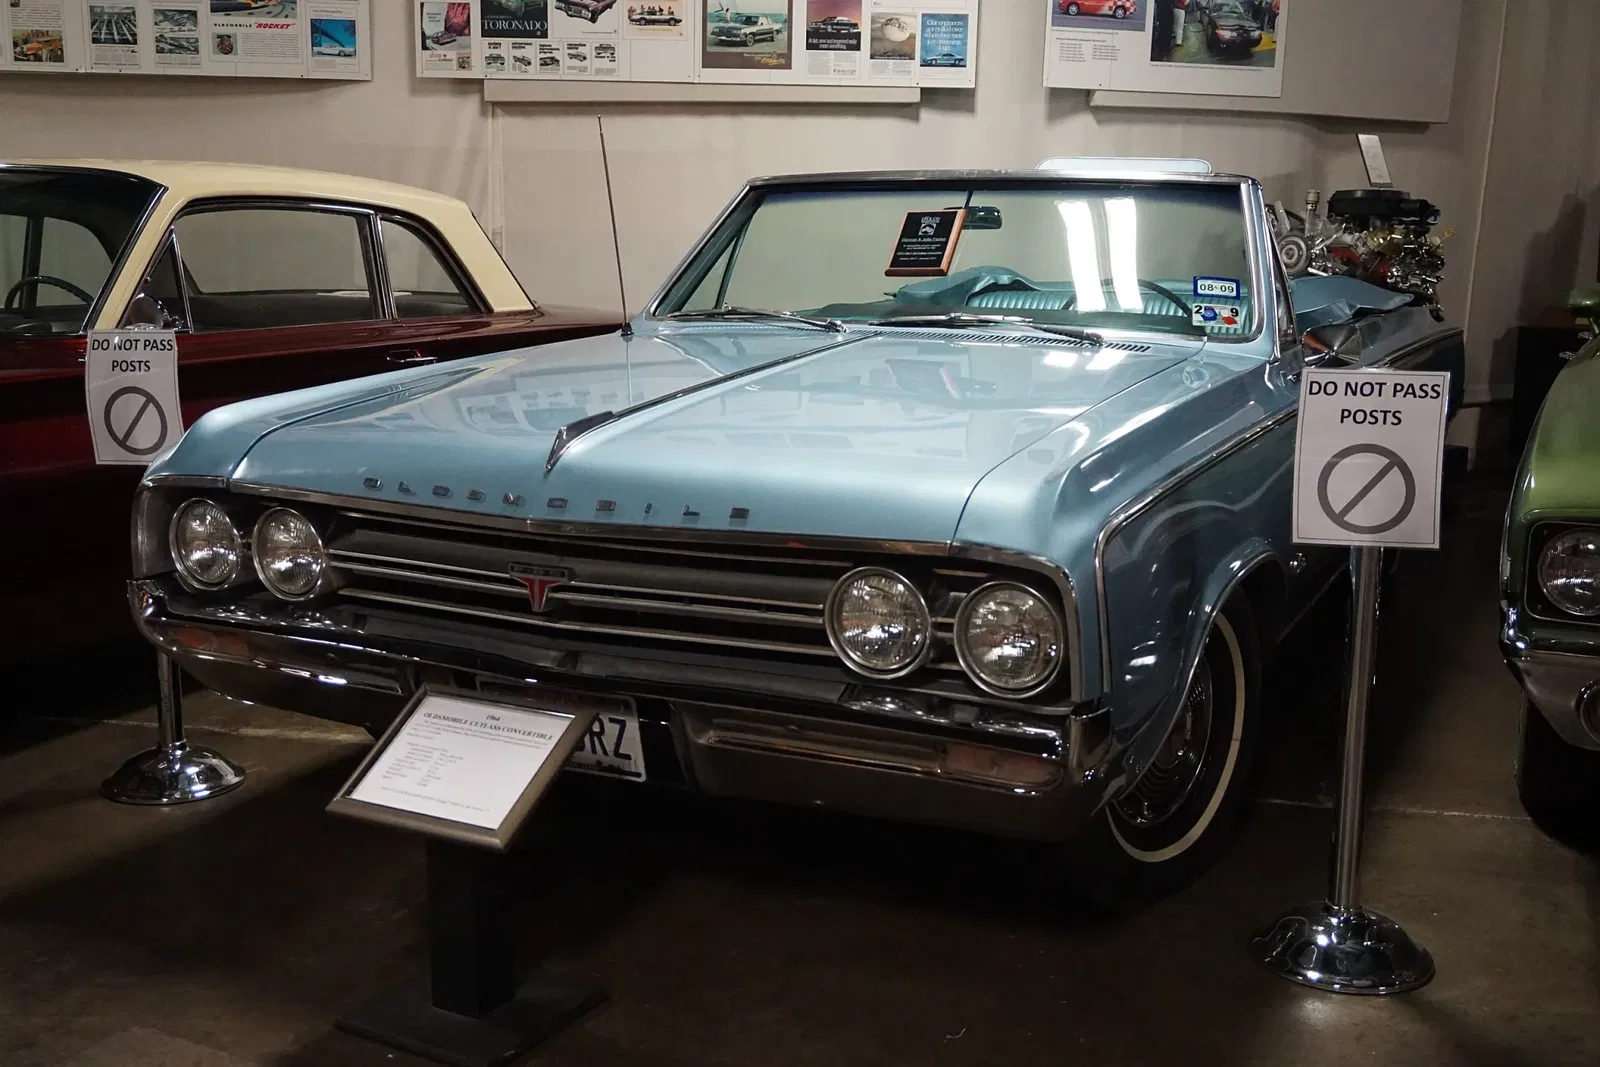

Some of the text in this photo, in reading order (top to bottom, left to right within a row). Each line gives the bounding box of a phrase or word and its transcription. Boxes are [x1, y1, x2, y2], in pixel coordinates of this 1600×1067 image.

[482, 19, 547, 31] TORONADO
[1200, 283, 1234, 293] 08 09
[92, 339, 173, 351] DO NOT PASS
[112, 360, 151, 372] POSTS
[1309, 381, 1441, 399] DO NOT PASS
[1340, 409, 1402, 426] POSTS
[363, 476, 750, 519] OLDSMOBILE
[423, 712, 470, 726] OLDSMOBILE
[469, 720, 502, 731] CUTLASS
[501, 725, 554, 741] CONVERTIBLE
